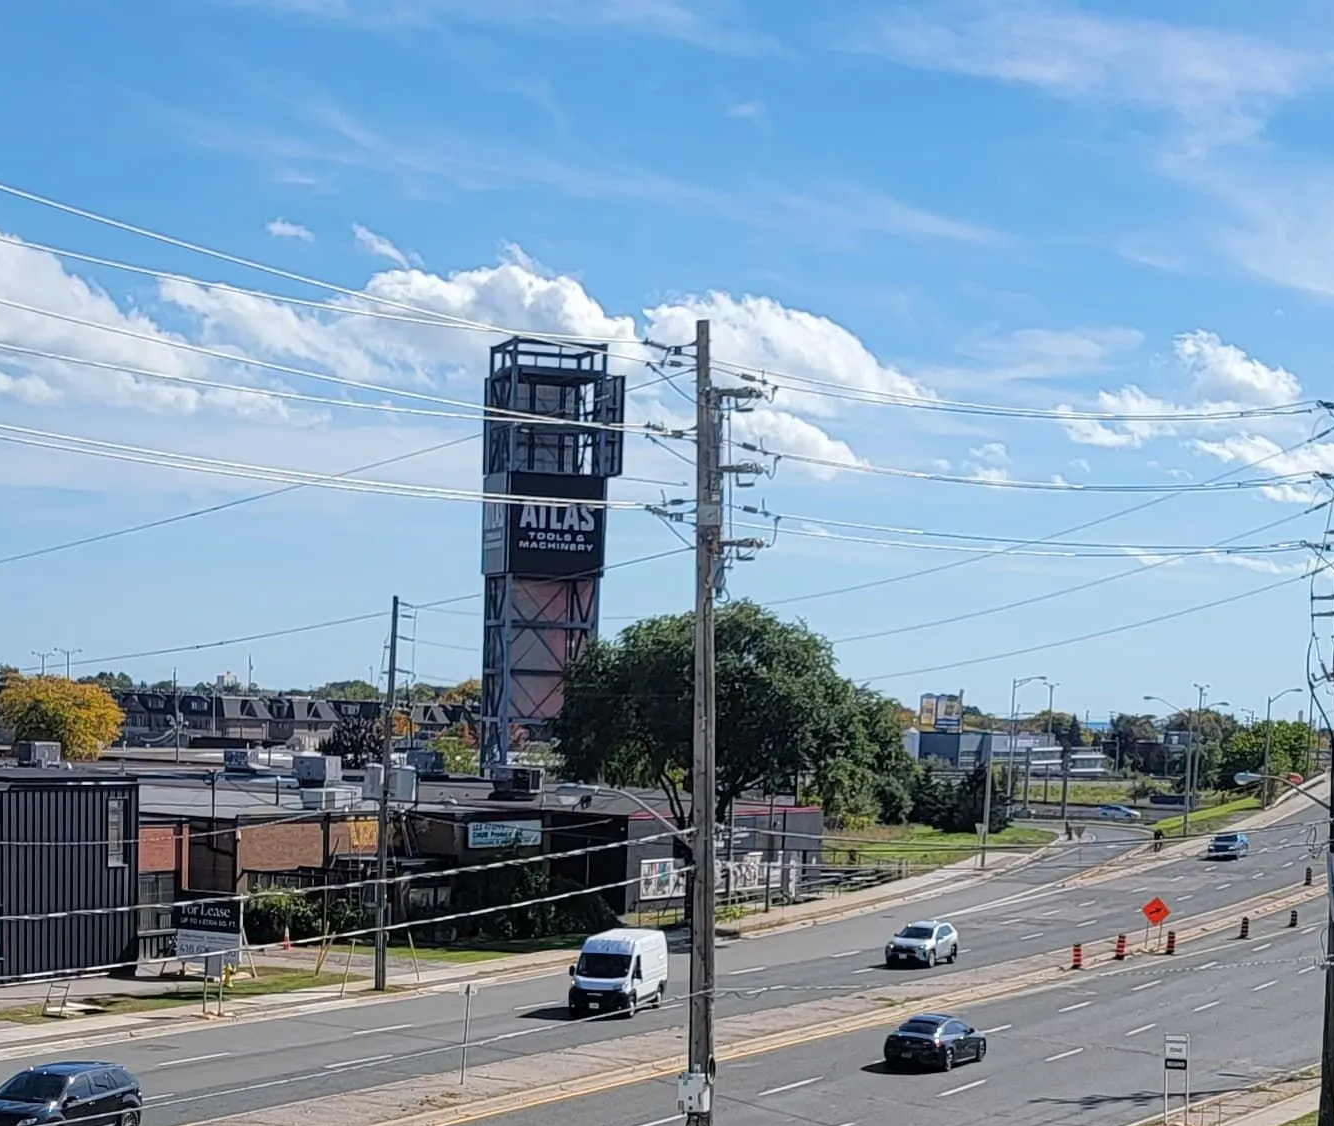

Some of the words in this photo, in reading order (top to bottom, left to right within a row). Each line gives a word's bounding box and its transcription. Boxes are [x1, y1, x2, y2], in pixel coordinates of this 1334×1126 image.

[528, 531, 572, 542] TOOLS
[518, 540, 594, 553] MACHINERY
[200, 902, 231, 919] Lease
